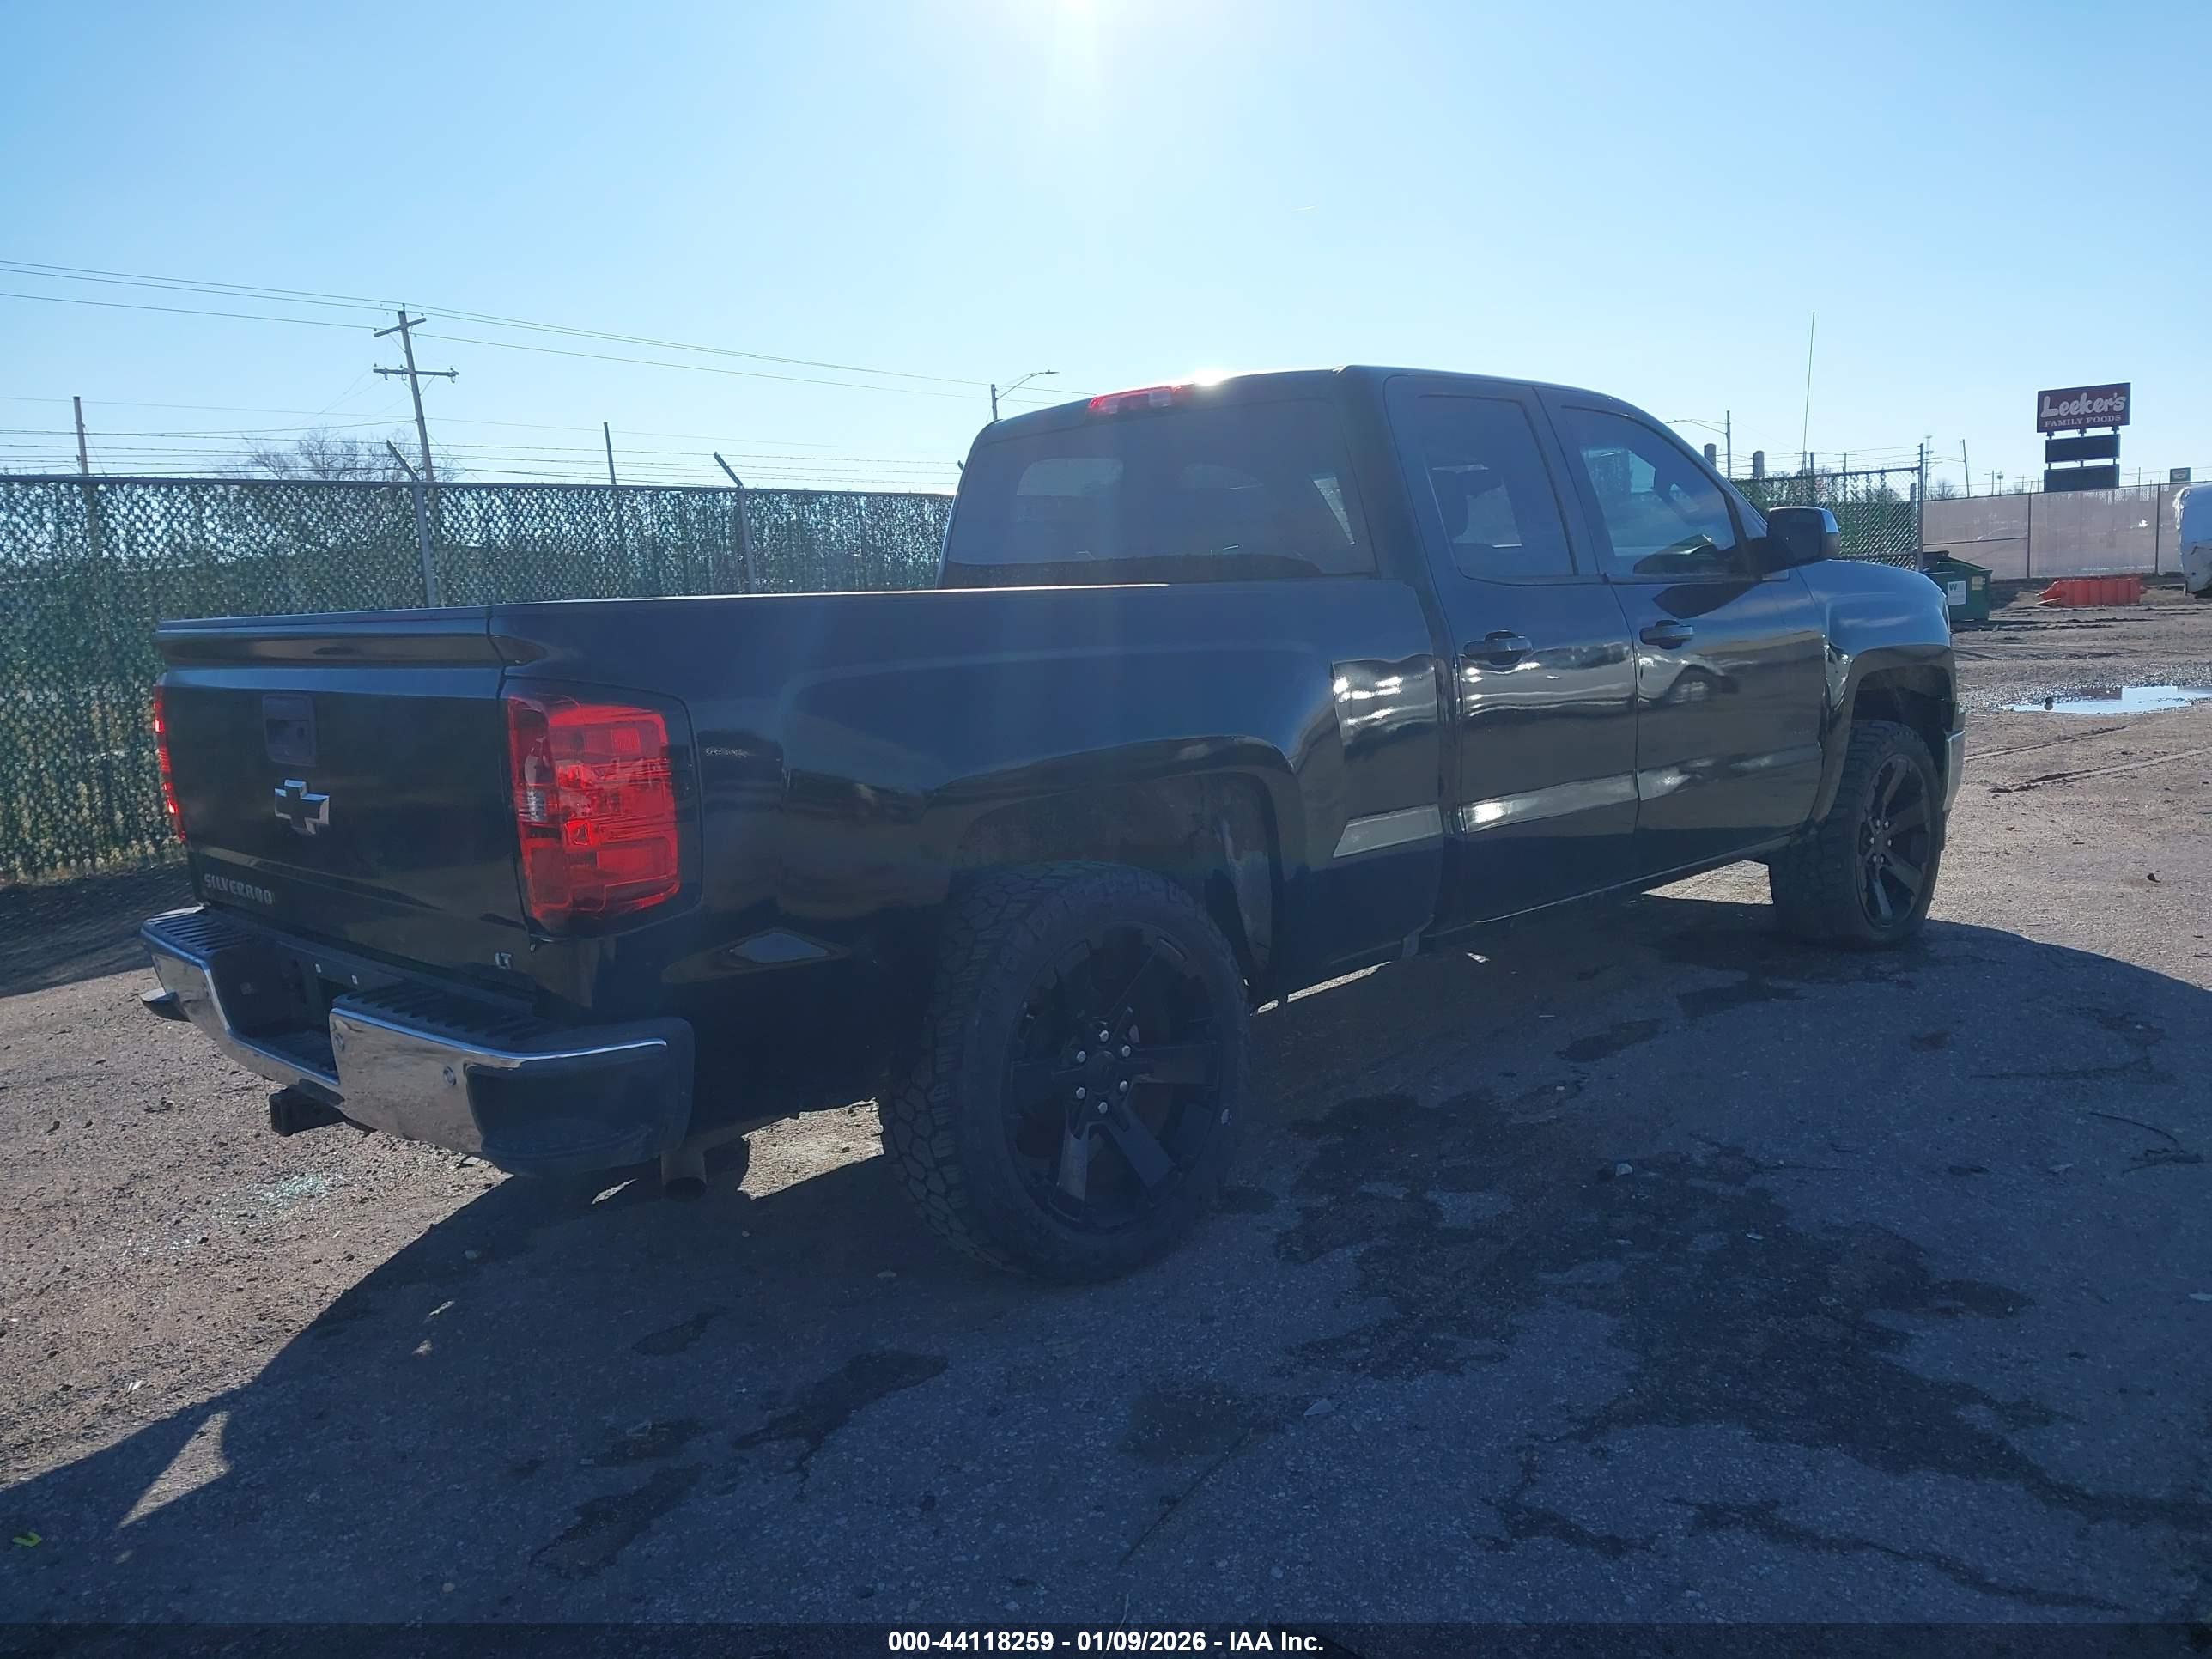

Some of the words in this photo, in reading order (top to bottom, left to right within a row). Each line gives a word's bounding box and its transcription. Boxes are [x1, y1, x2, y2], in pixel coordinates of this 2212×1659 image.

[2040, 392, 2127, 418] Leeker's
[2045, 417, 2084, 428] FAMILY
[2086, 415, 2122, 424] FOODS
[204, 873, 273, 905] SILVERADO
